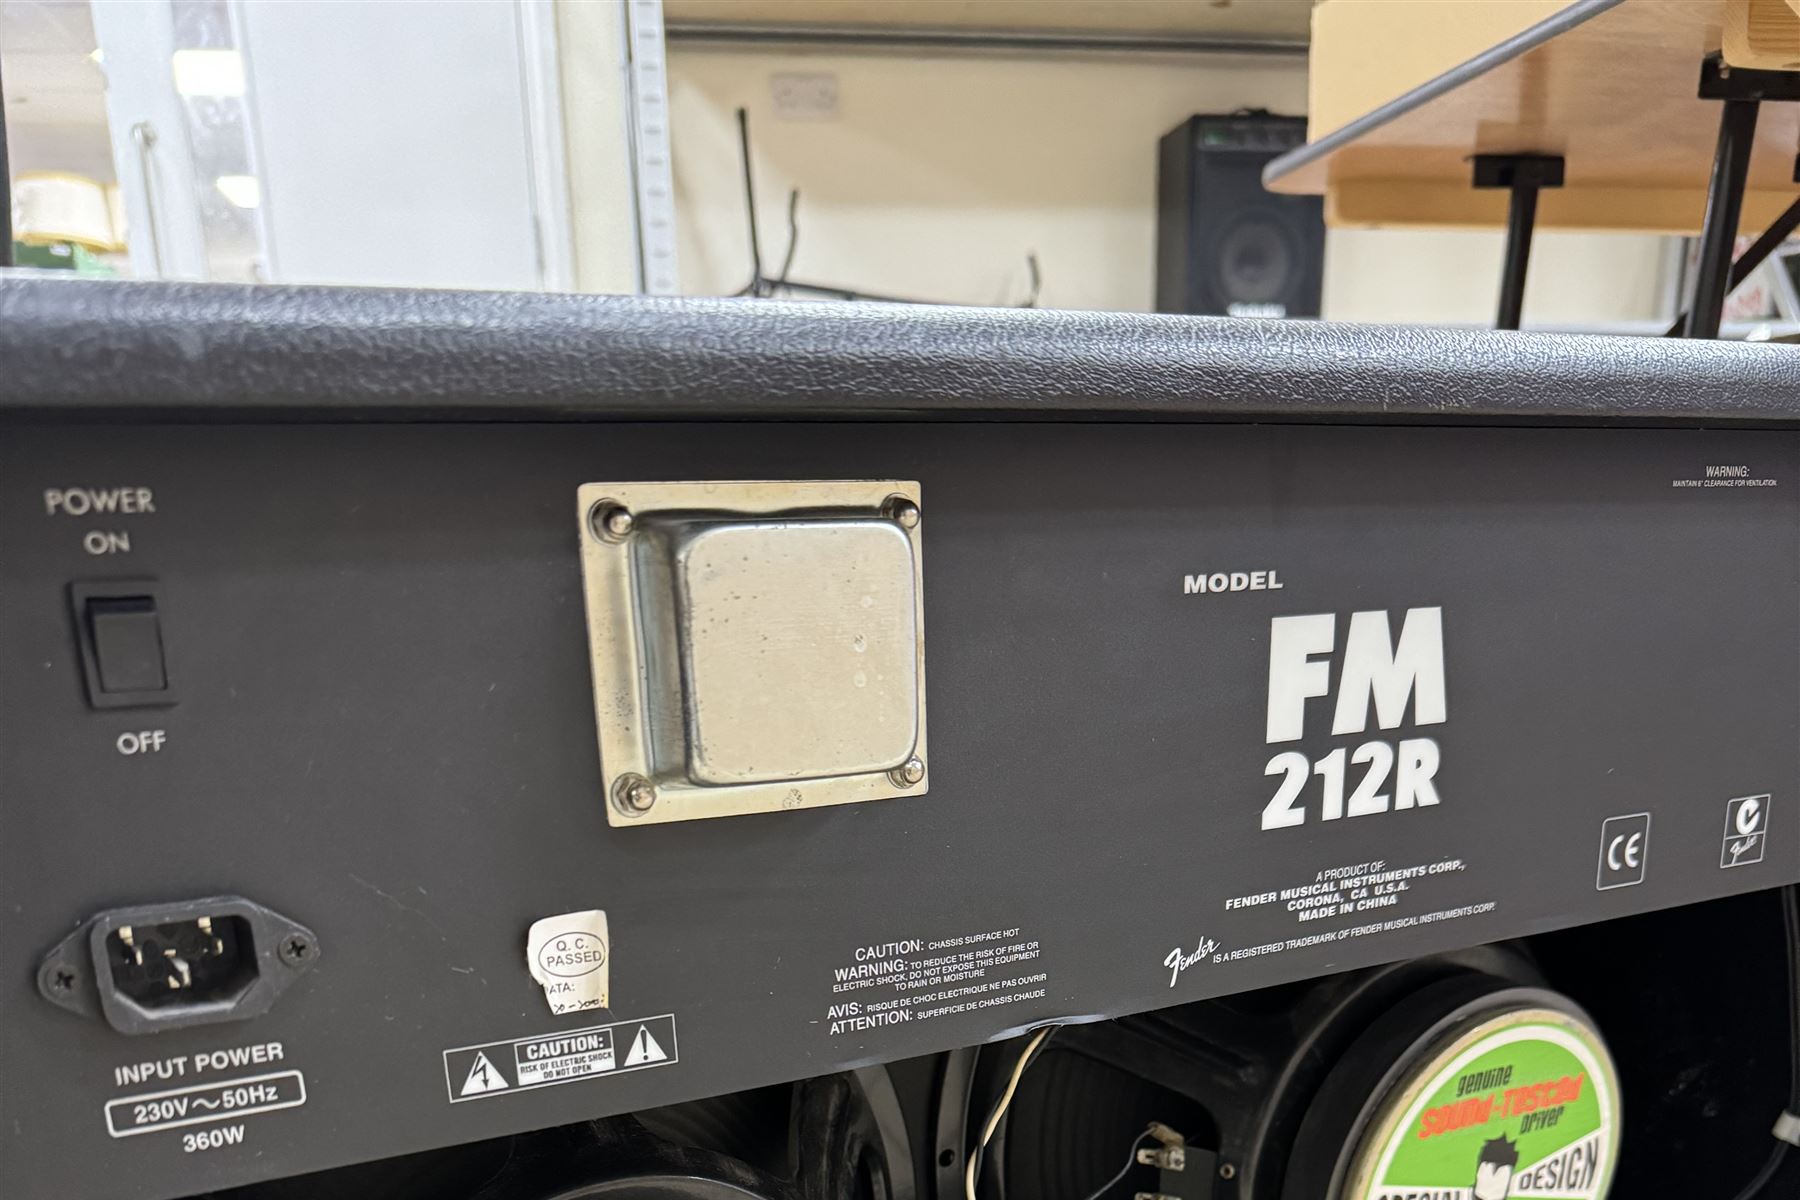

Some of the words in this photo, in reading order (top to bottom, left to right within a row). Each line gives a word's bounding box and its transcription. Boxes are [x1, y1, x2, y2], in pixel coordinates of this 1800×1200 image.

[1706, 466, 1750, 478] WARNING:
[44, 487, 156, 515] POWER
[83, 531, 130, 555] ON
[1183, 570, 1283, 594] MODEL
[1266, 606, 1447, 744] FM
[116, 729, 166, 755] OFF
[1261, 737, 1441, 831] 212R
[1316, 872, 1323, 883] A
[1324, 863, 1369, 881] PRODUCT
[1370, 860, 1386, 873] OF:
[1225, 892, 1277, 910] FENDER
[1280, 882, 1336, 901] MUSICAL
[1340, 865, 1428, 890] INSTRUMENTS
[1287, 892, 1344, 911] CORONA,
[1351, 888, 1368, 900] CA
[1374, 881, 1410, 896] U.S.A.
[1299, 905, 1336, 922] MADE
[1340, 902, 1354, 914] IN
[1357, 894, 1398, 911] CHINA
[556, 940, 571, 951] Q.
[575, 938, 588, 949] C.
[855, 939, 924, 961] CAUTION:
[928, 938, 963, 950] CHASSIS
[965, 931, 1002, 944] SURFACE
[1003, 928, 1020, 938] HOT
[1163, 936, 1221, 988] Fender
[1213, 954, 1222, 963] IS
[1223, 952, 1229, 962] A
[1231, 942, 1284, 961] REGISTERED
[1285, 931, 1337, 949] TRADEMARK
[1338, 929, 1350, 939] OF
[1351, 923, 1382, 937] FENDER
[1384, 915, 1419, 931] MUSICAL
[1419, 906, 1472, 923] INSTRUMENTS
[1473, 901, 1496, 914] CORP.
[547, 950, 602, 968] PASSED
[833, 979, 875, 993] ELECTRIC
[876, 973, 908, 985] SHOCK,
[909, 971, 922, 980] DO
[924, 967, 941, 977] NOT
[942, 962, 975, 974] EXPOSE
[976, 958, 994, 968] THIS
[995, 950, 1040, 965] EQUIPMENT
[834, 959, 908, 982] WARNING:
[910, 961, 922, 969] TO
[923, 955, 957, 968] REDUCE
[959, 952, 974, 962] THE
[975, 949, 995, 959] RISK
[996, 946, 1007, 955] OF
[1008, 943, 1026, 953] FIRE
[1027, 941, 1039, 950] OR
[546, 982, 575, 994] ATA:
[895, 983, 907, 991] TO
[908, 979, 928, 989] RAIN
[929, 976, 942, 985] OR
[943, 969, 985, 983] MOISTURE
[827, 1002, 862, 1020] AVIS:
[867, 999, 899, 1013] RISQUE
[900, 998, 911, 1007] DE
[913, 993, 937, 1005] CHOC
[938, 984, 988, 1000] ELECTRIQUE
[989, 982, 1000, 991] NE
[1001, 979, 1017, 989] PAS
[1018, 973, 1047, 985] OUVRIR
[830, 1009, 913, 1036] ATTENTION:
[917, 1004, 965, 1020] SUPERFICIE
[966, 1002, 978, 1011] DE
[978, 995, 1012, 1008] CHASSIS
[1013, 989, 1046, 1002] CHAUDE
[526, 1034, 604, 1060] CAUTION:
[114, 1057, 187, 1086] INPUT
[195, 1042, 284, 1072] POWER
[520, 1064, 538, 1074] RISK
[540, 1062, 549, 1071] OF
[551, 1056, 587, 1069] ELECTRIC
[588, 1051, 613, 1062] SHOCK
[543, 1071, 553, 1079] DO
[556, 1068, 570, 1077] NOT
[572, 1064, 592, 1074] OPEN
[1456, 1064, 1513, 1097] genuine
[183, 1124, 245, 1152] 360W
[1519, 1138, 1599, 1190] DESIGN
